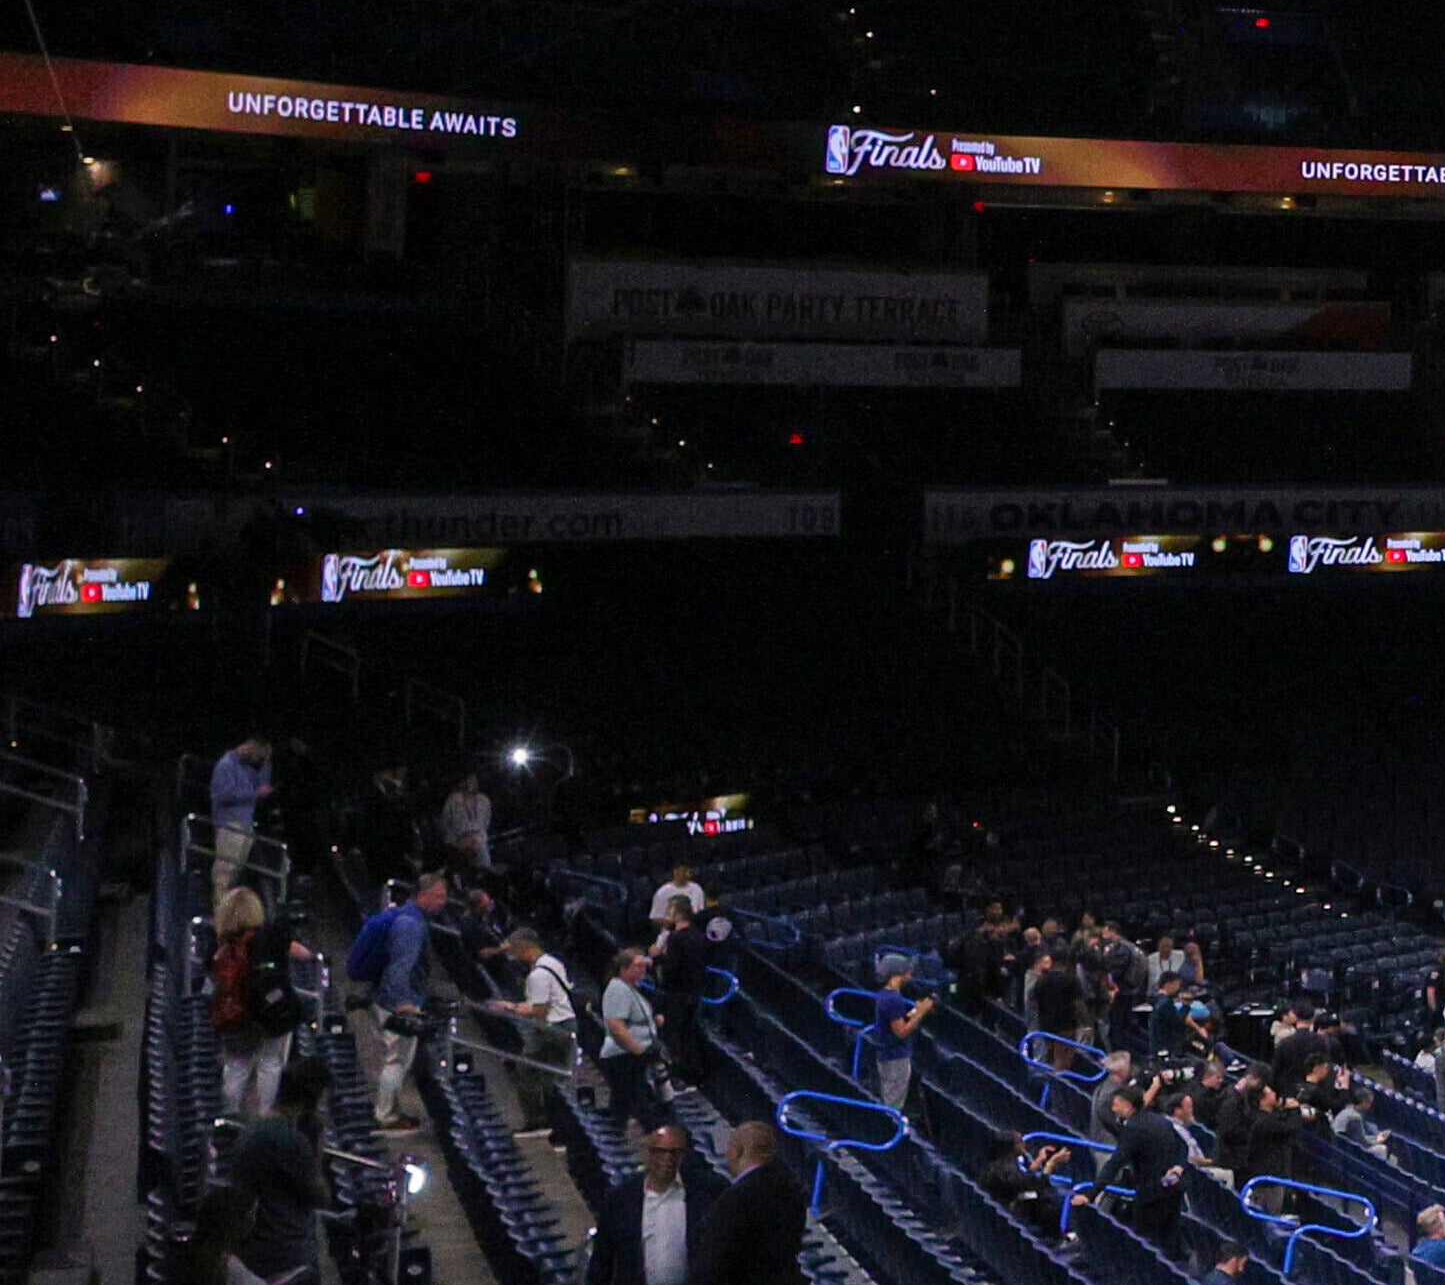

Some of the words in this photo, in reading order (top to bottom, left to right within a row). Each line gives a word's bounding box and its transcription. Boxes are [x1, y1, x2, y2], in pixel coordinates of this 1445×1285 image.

[228, 91, 423, 130] UNFORGETTABLE
[427, 111, 517, 138] AWAITS
[846, 130, 947, 176] Finals
[976, 155, 1022, 175] YouTube
[1022, 156, 1041, 174] TV
[613, 289, 671, 316] POST
[711, 291, 756, 317] OAK
[767, 292, 846, 320] PARTY
[854, 295, 963, 322] TERRACE
[990, 498, 1282, 532] OKLAHOMA
[1302, 499, 1400, 531] CITY
[1046, 539, 1120, 579] Finals
[1304, 536, 1383, 574] Finals
[337, 549, 405, 603] Finals
